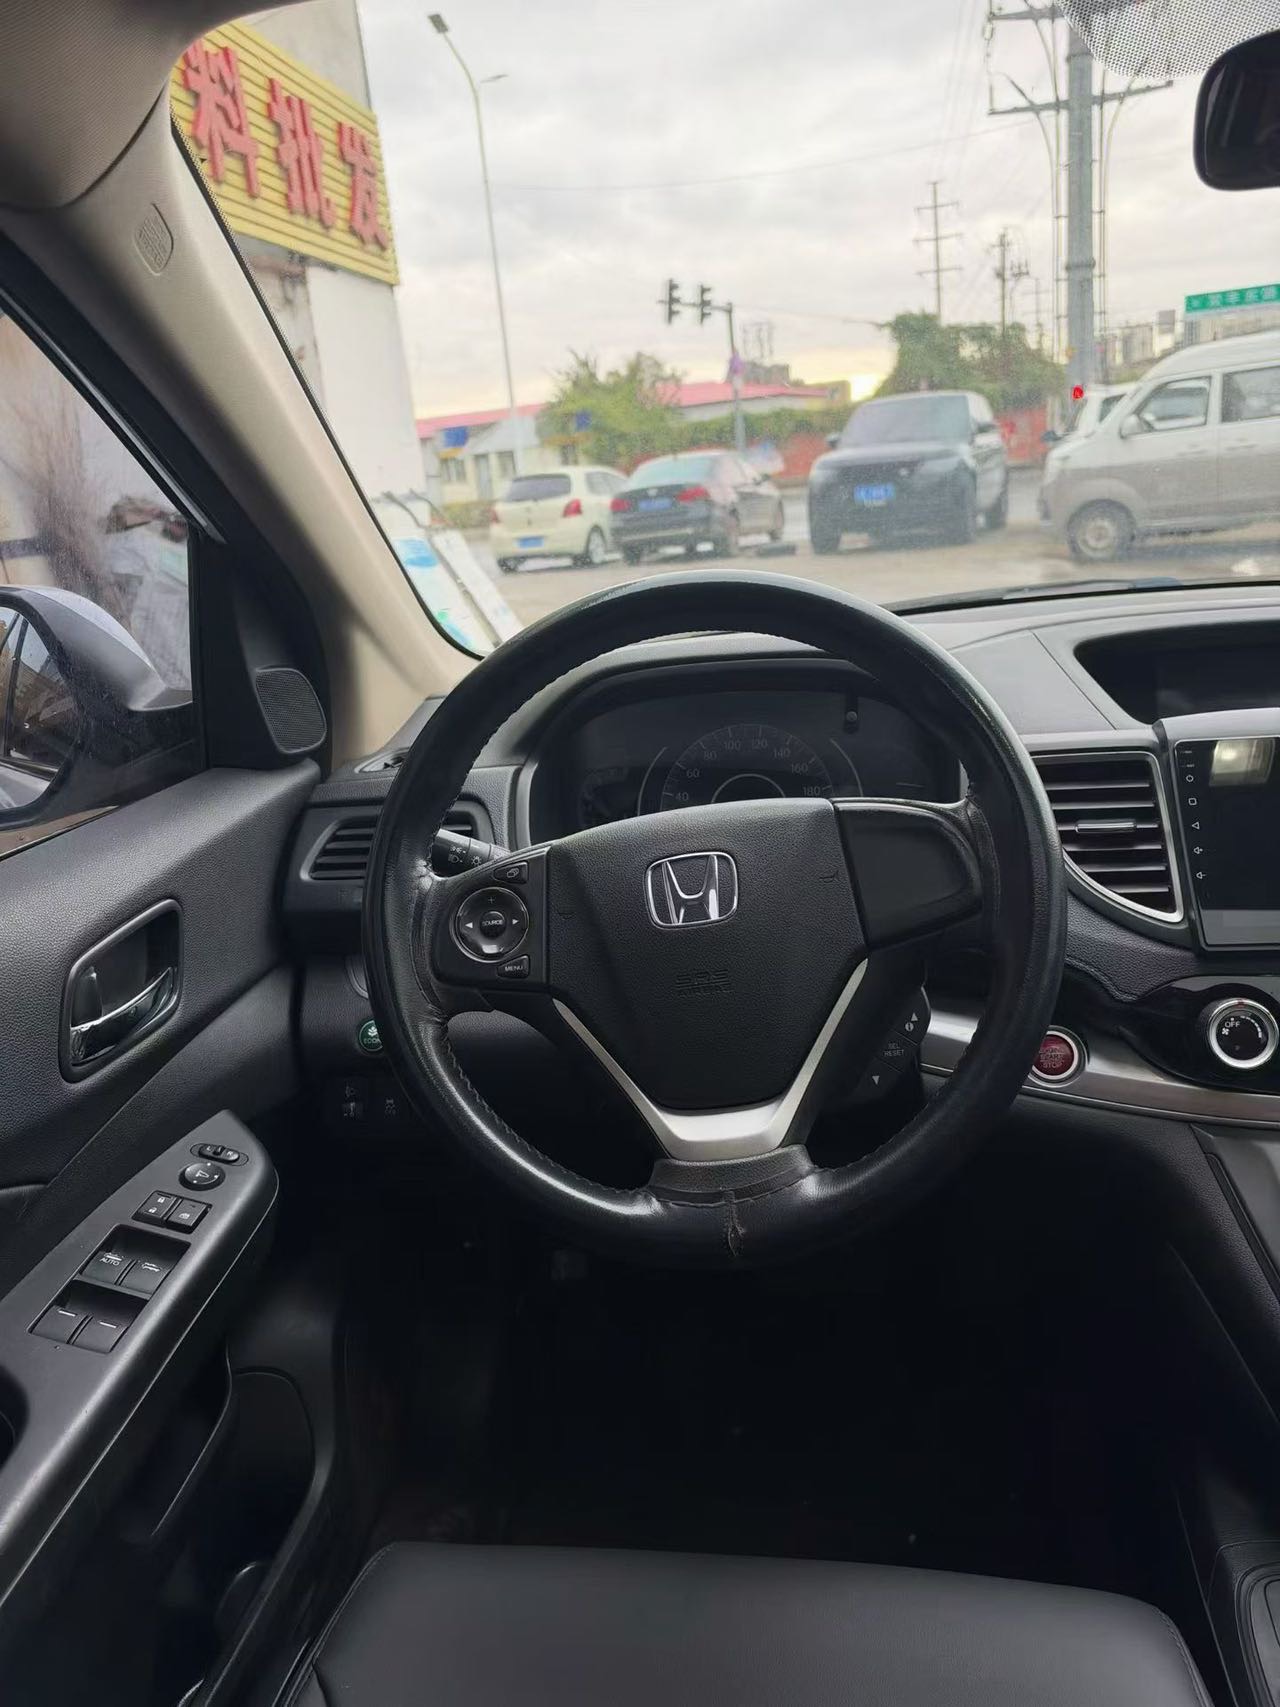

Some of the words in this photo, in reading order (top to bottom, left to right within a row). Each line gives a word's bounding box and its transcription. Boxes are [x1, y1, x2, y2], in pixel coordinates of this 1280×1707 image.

[724, 740, 741, 750] 100
[752, 739, 768, 749] 120
[704, 750, 717, 760] 80
[774, 748, 790, 759] 140
[686, 769, 699, 778] 60
[792, 764, 808, 775] 160
[803, 786, 821, 796] 180
[675, 792, 689, 801] 40
[884, 1049, 904, 1057] RESET
[99, 1257, 120, 1266] AUTO
